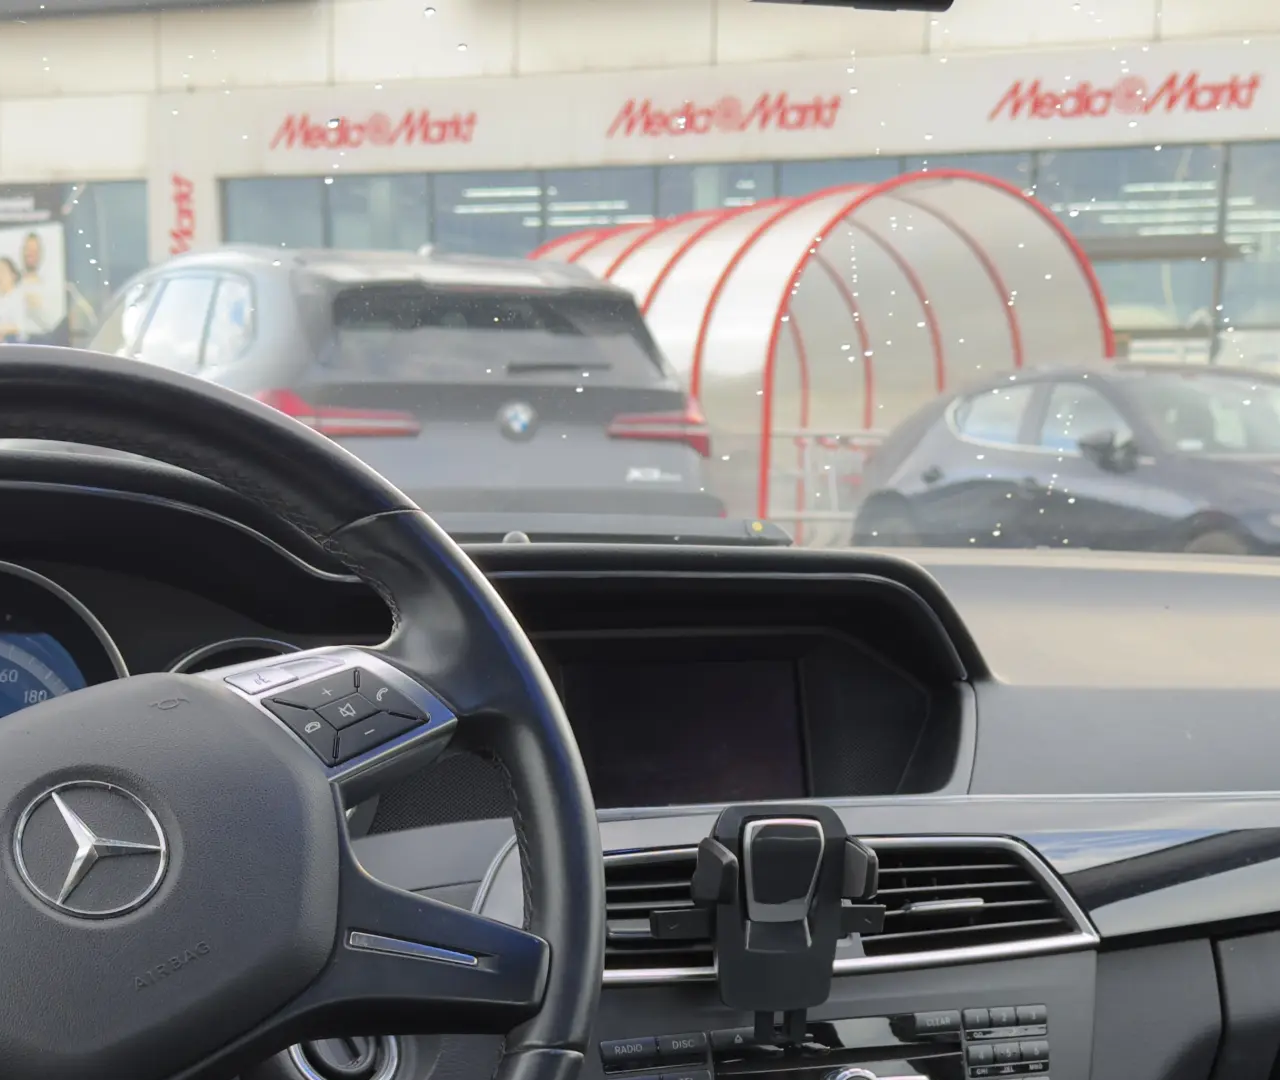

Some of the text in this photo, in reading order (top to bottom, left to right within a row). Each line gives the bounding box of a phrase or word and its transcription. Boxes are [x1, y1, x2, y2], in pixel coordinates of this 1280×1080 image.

[23, 690, 47, 704] 180
[614, 1040, 696, 1054] RADIO DISC
